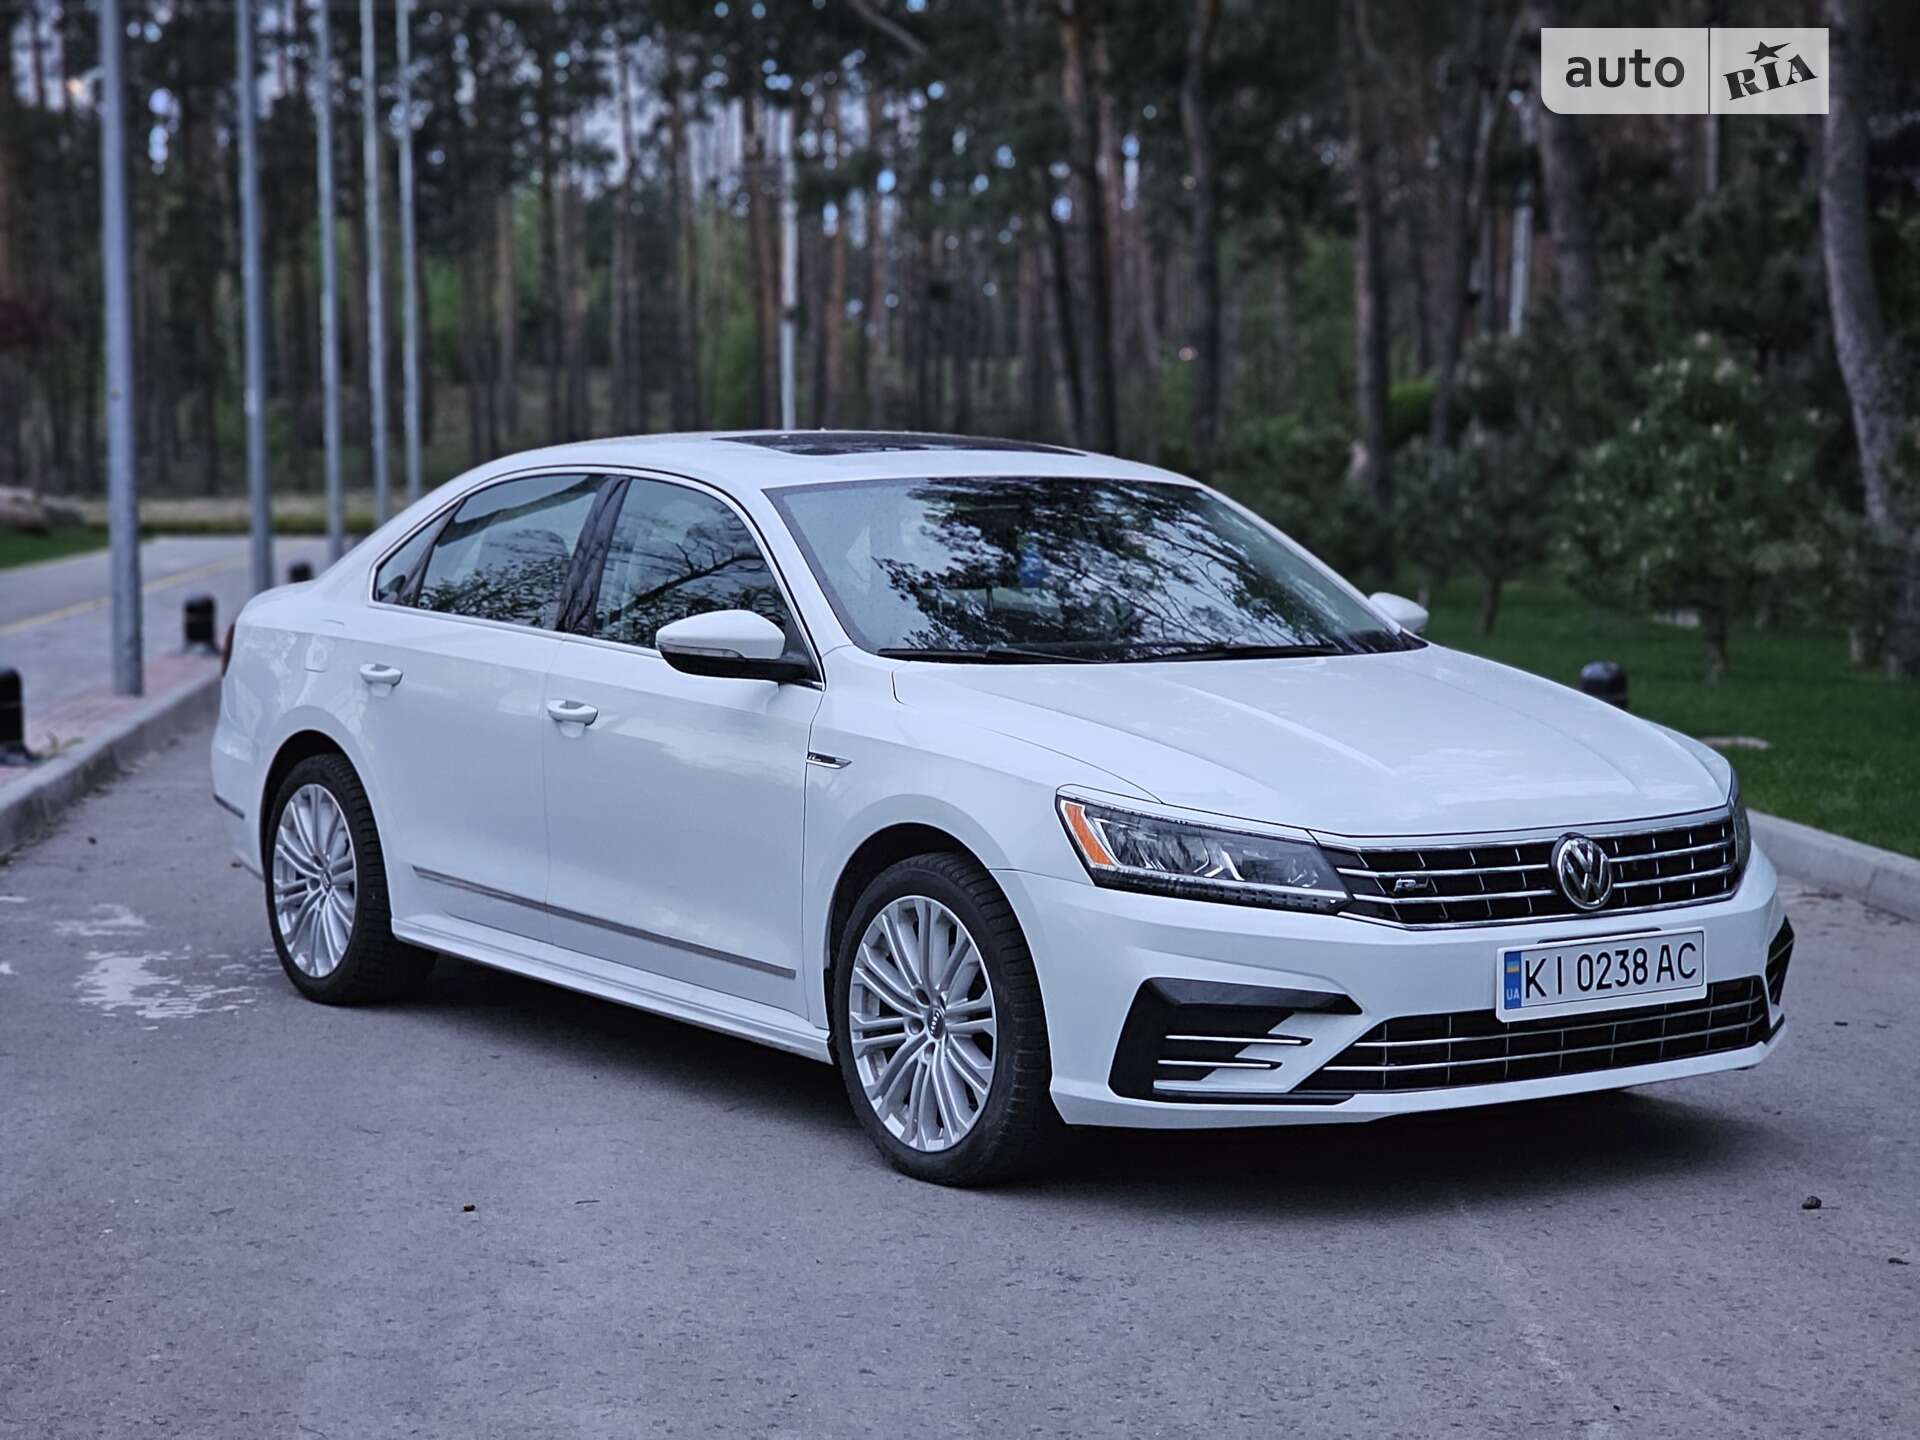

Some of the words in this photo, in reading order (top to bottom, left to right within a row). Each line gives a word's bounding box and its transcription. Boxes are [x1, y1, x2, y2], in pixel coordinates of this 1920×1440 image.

[1525, 956, 1563, 998] KI
[1577, 948, 1648, 991] 0238
[1656, 942, 1697, 983] AC
[1506, 989, 1520, 1000] UA
